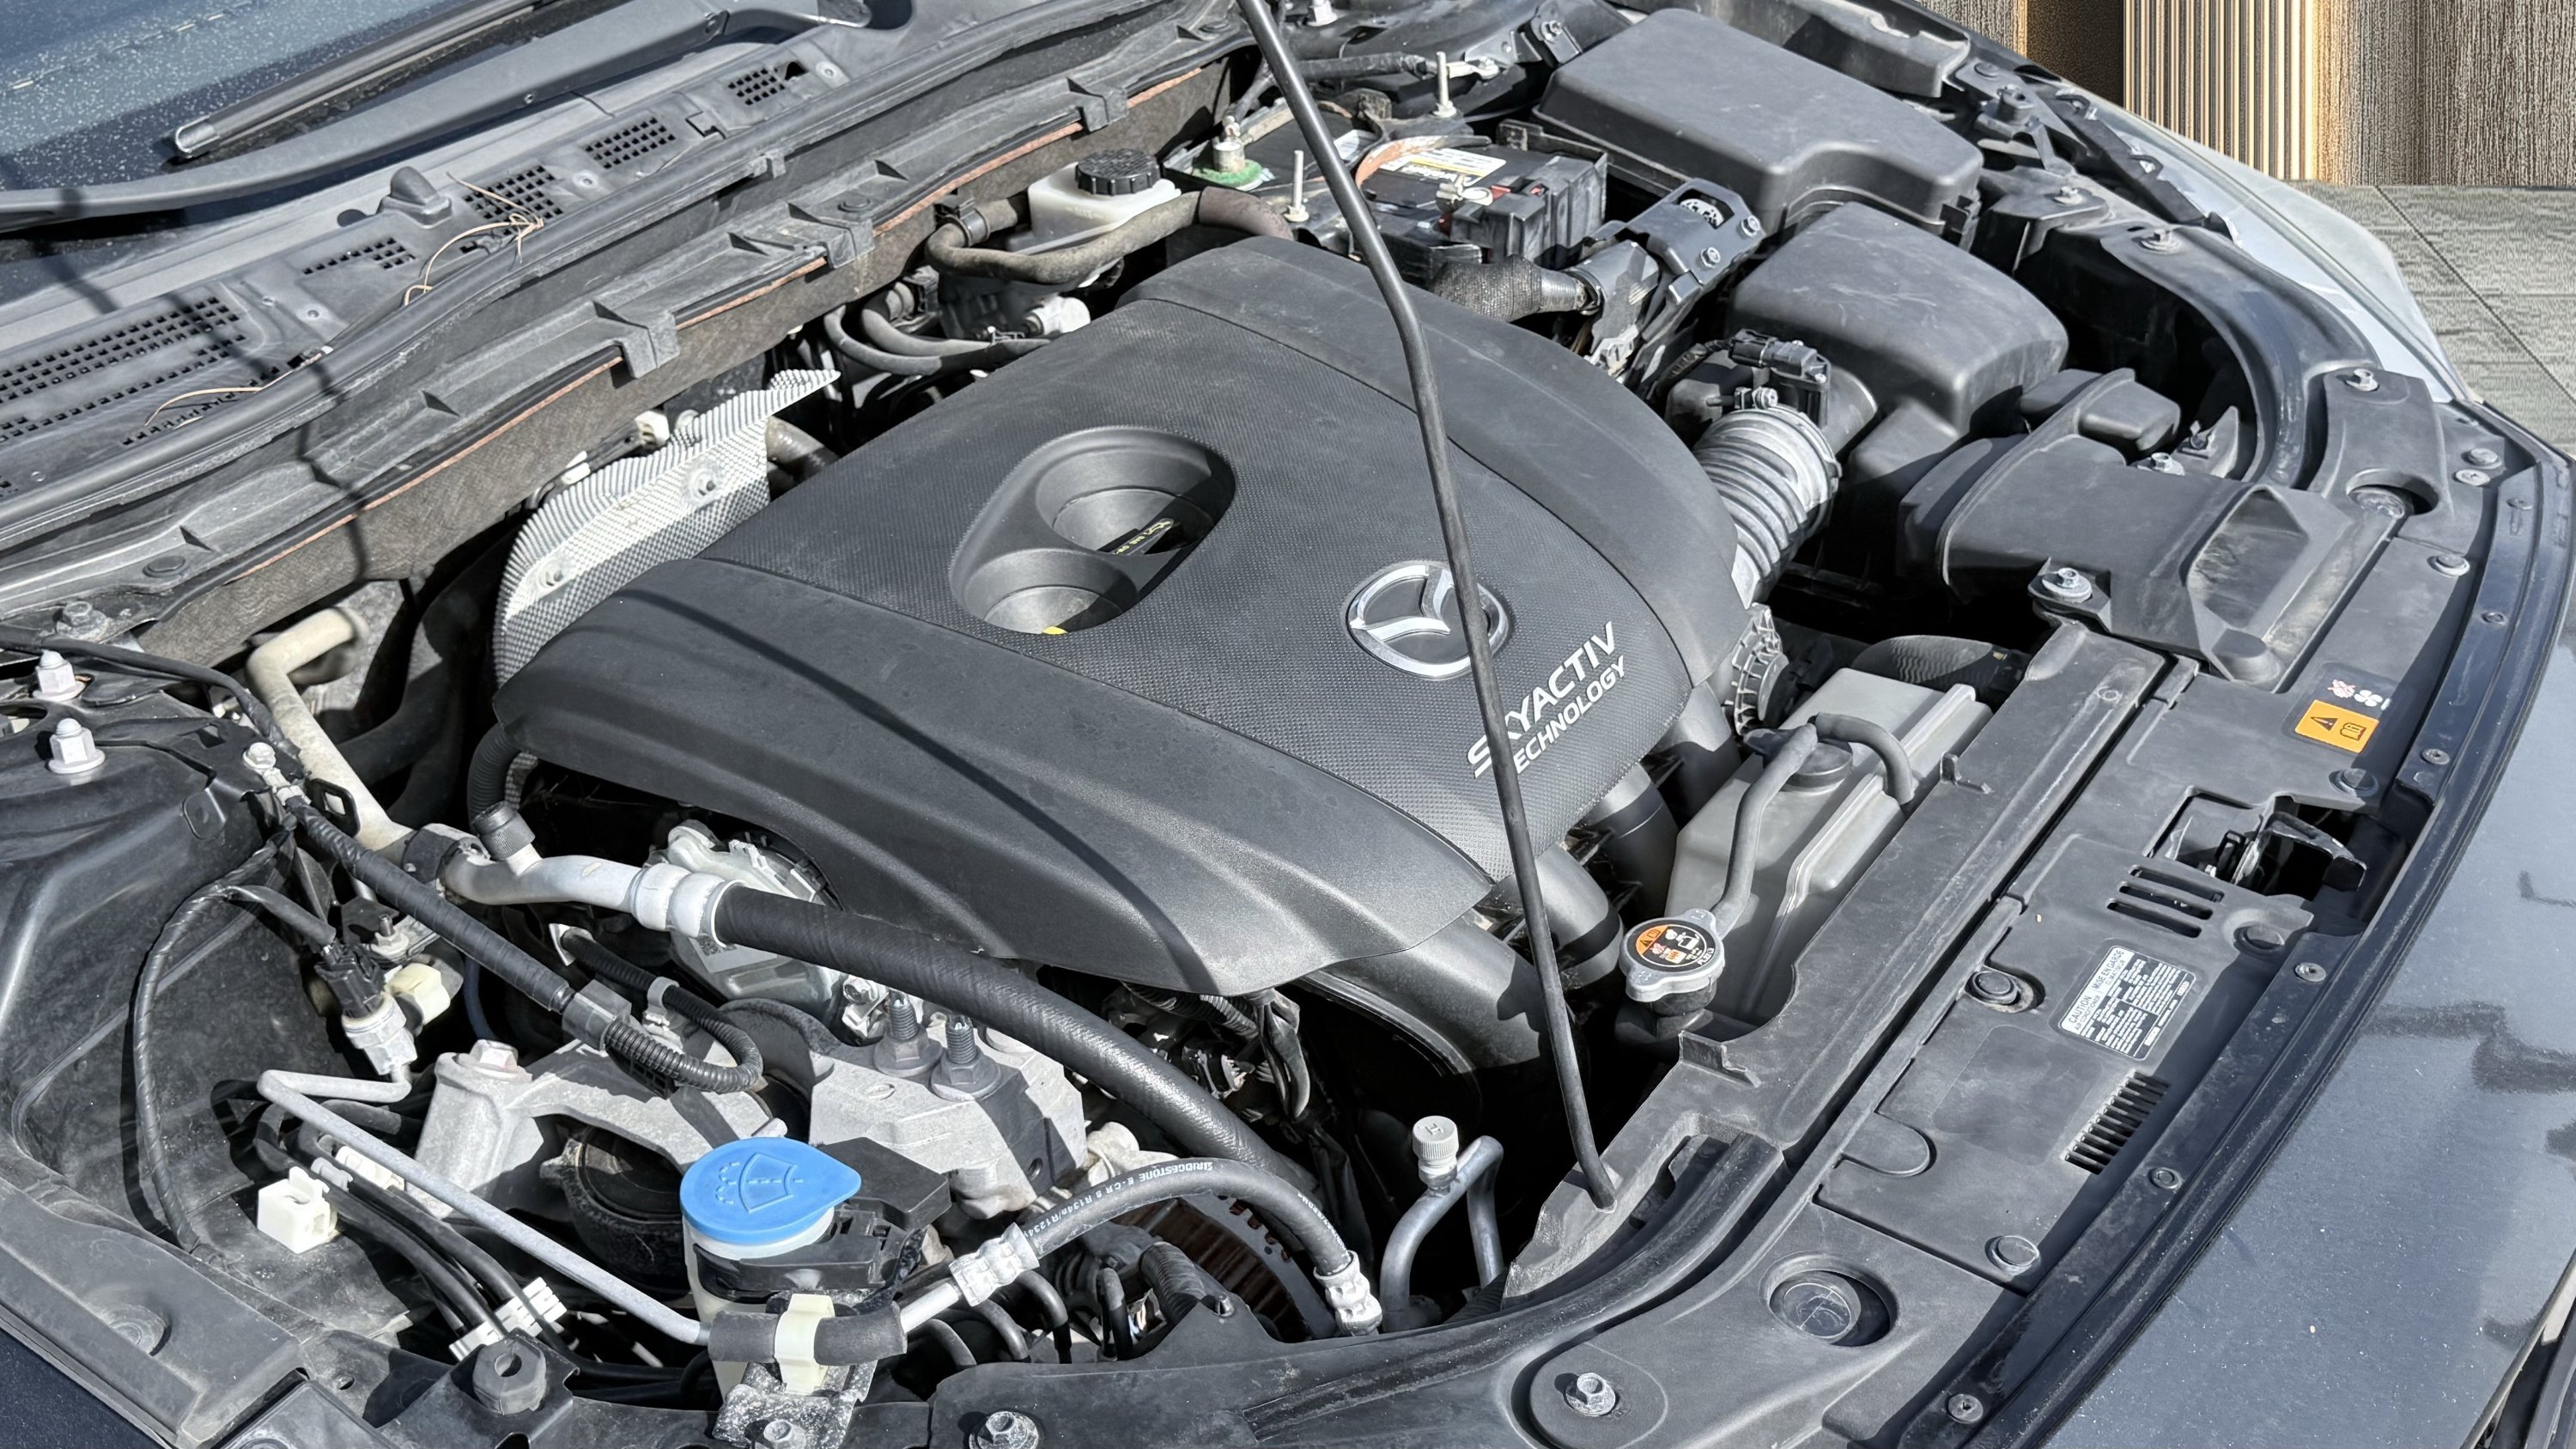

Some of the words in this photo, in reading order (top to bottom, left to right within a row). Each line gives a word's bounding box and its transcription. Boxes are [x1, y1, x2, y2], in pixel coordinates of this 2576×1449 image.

[1514, 655, 1625, 774] ECHNOLOGY
[2069, 995, 2093, 1024] CAUTION
[1139, 1161, 1213, 1183] BRIDGESTONE
